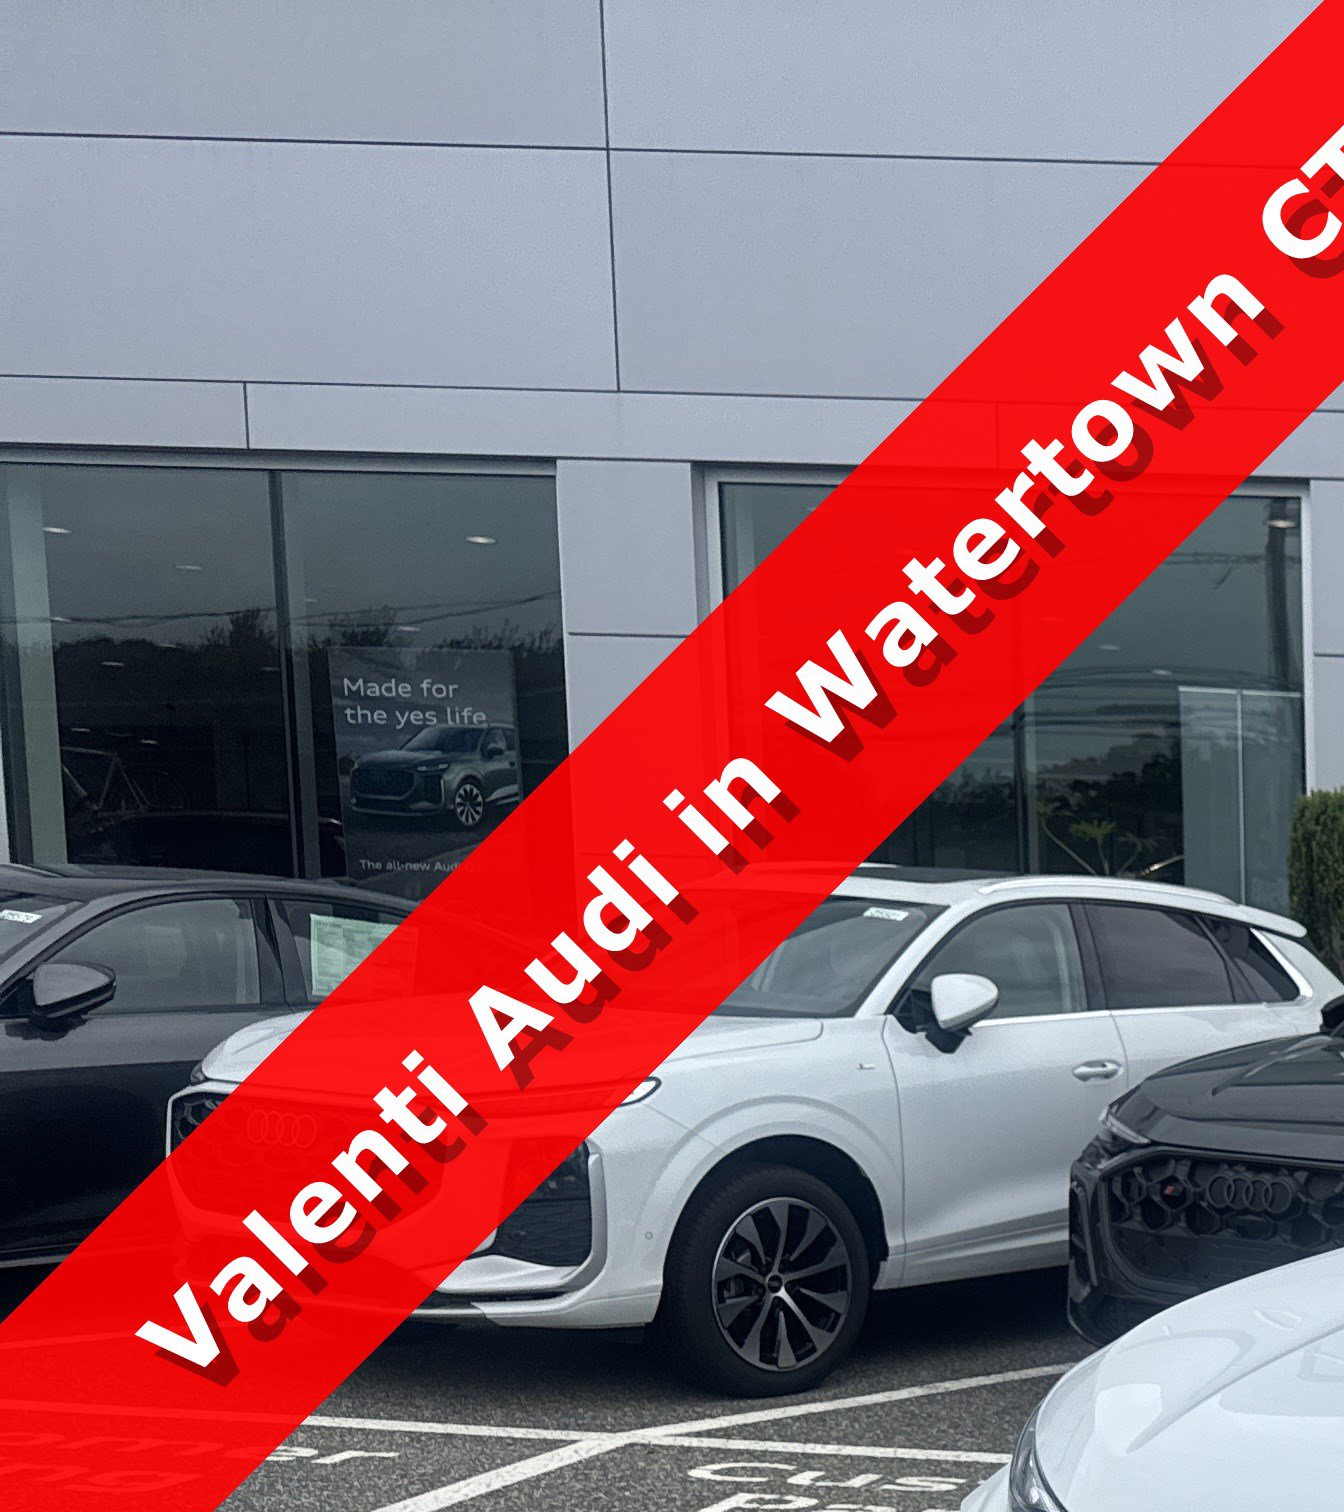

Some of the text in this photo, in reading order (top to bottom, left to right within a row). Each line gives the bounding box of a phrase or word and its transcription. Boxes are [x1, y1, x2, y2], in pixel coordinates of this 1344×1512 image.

[343, 678, 459, 698] Made for
[344, 705, 487, 729] the yes life
[360, 859, 382, 871] The
